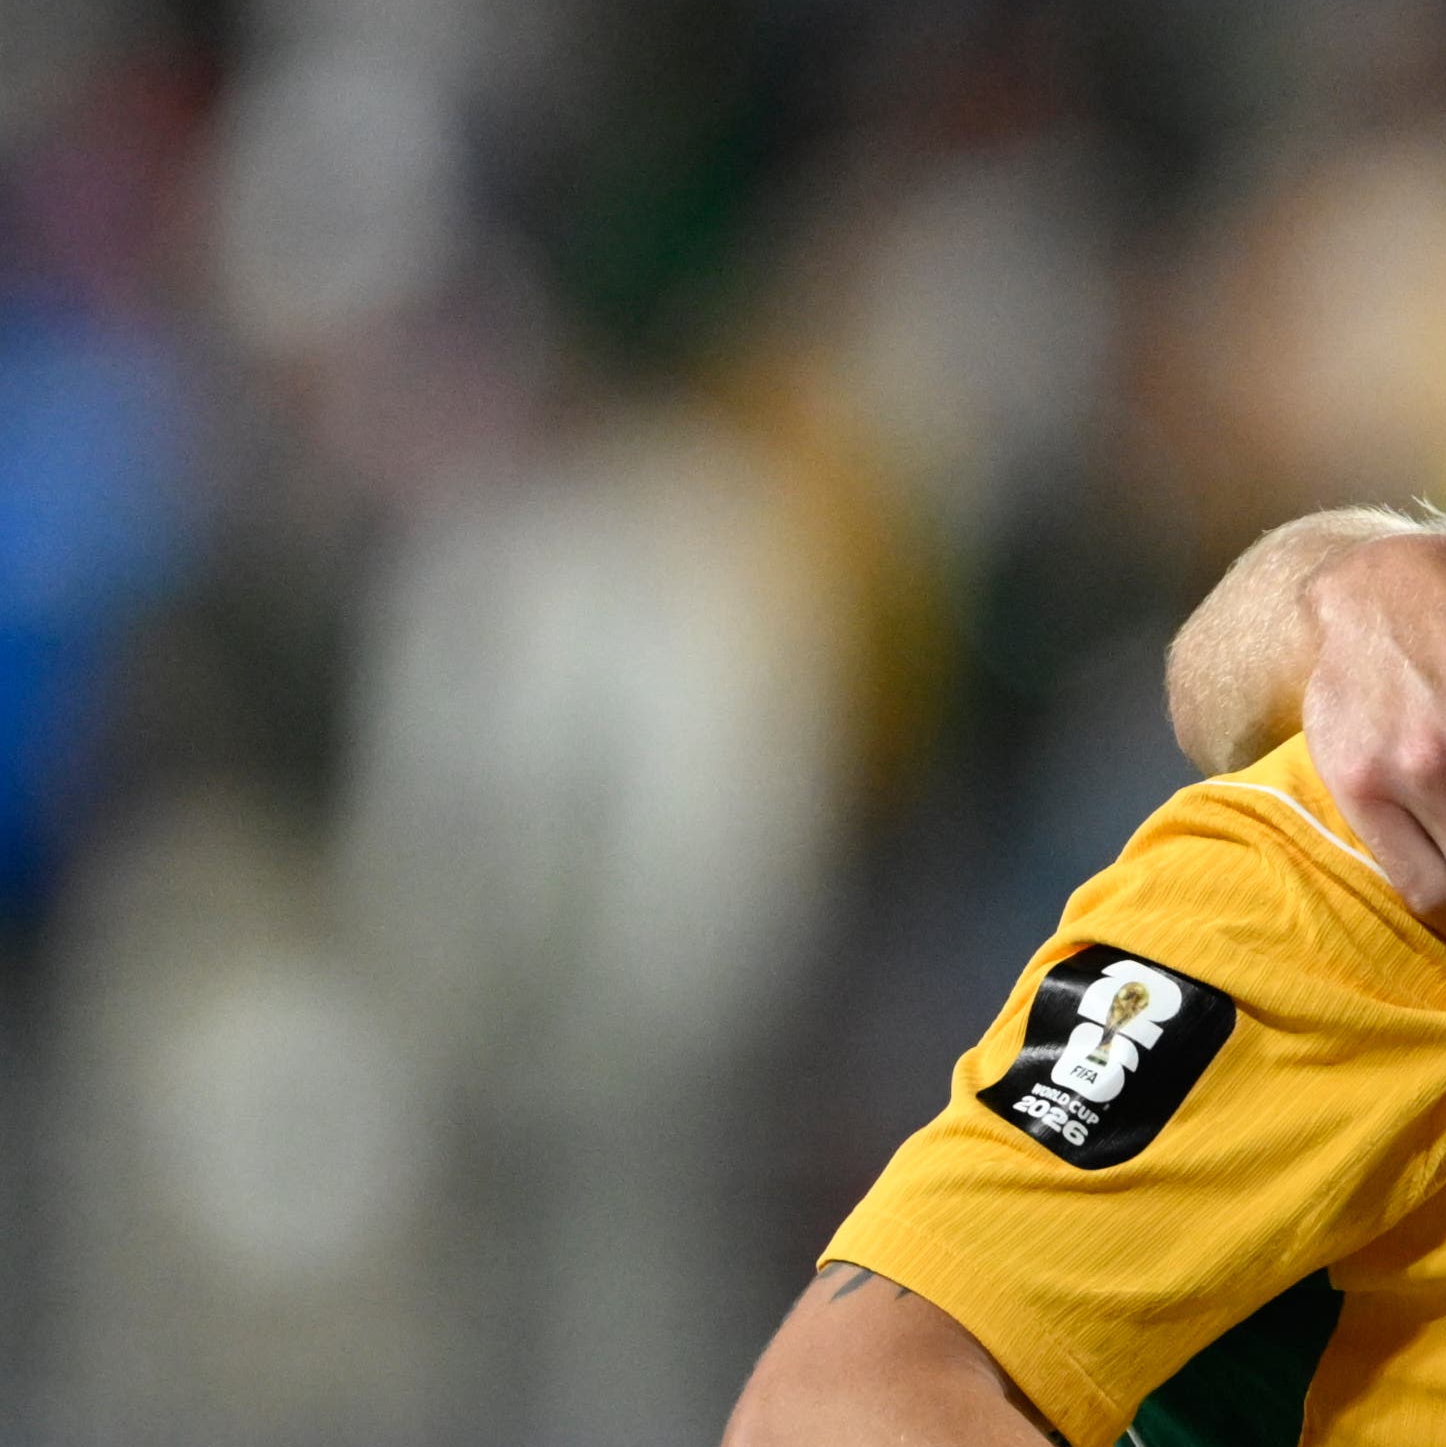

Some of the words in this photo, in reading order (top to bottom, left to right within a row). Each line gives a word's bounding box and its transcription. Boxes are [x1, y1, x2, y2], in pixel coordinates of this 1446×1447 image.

[1070, 1065, 1098, 1084] FIFA
[1012, 1095, 1089, 1146] 2026
[1031, 1083, 1070, 1106] WORLD
[1068, 1100, 1100, 1125] CUP
